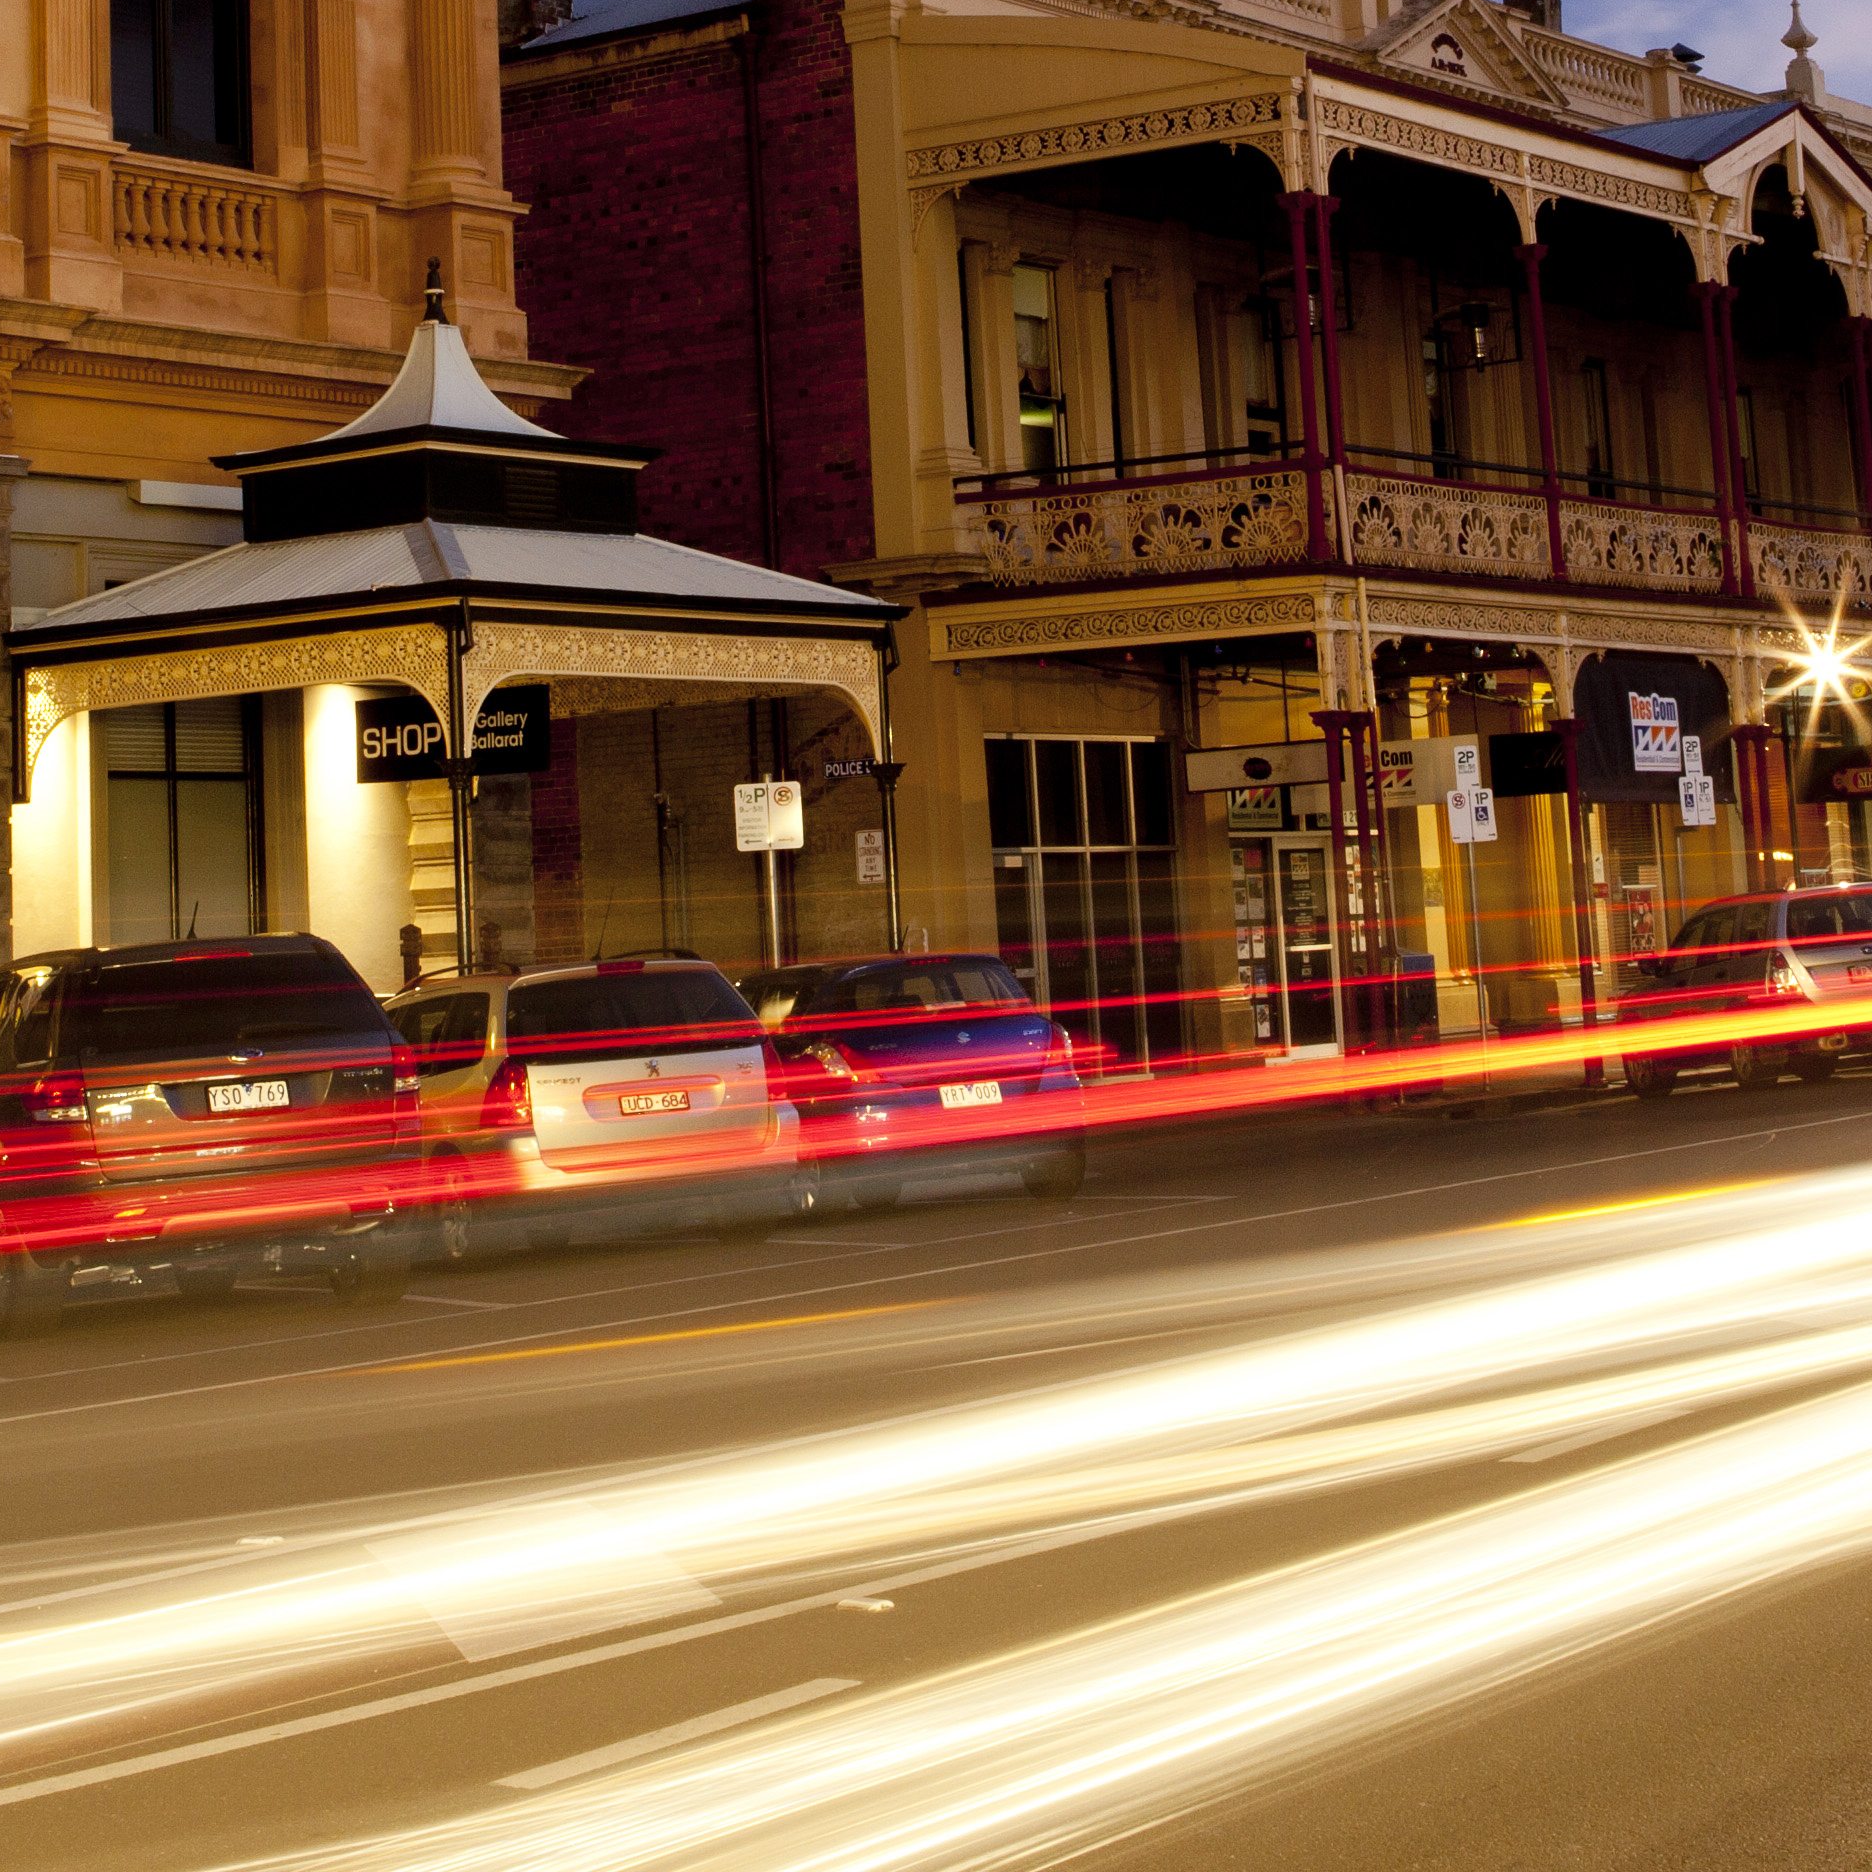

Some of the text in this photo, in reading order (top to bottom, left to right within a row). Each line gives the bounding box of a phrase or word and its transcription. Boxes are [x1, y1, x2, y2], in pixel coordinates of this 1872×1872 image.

[1631, 695, 1676, 721] ResCom
[476, 711, 528, 729] Gallery
[363, 722, 442, 759] SHOP
[471, 730, 524, 750] Ballarat
[1685, 740, 1698, 752] 2P
[1457, 750, 1475, 764] 2P
[825, 761, 863, 777] POLICE
[1682, 781, 1693, 793] 1P
[1699, 781, 1710, 793] 1P
[738, 787, 766, 804] 1/2P
[1474, 792, 1489, 804] 1P
[864, 834, 875, 845] NO
[209, 1084, 285, 1107] YSO 769
[942, 1085, 998, 1104] YRT 009
